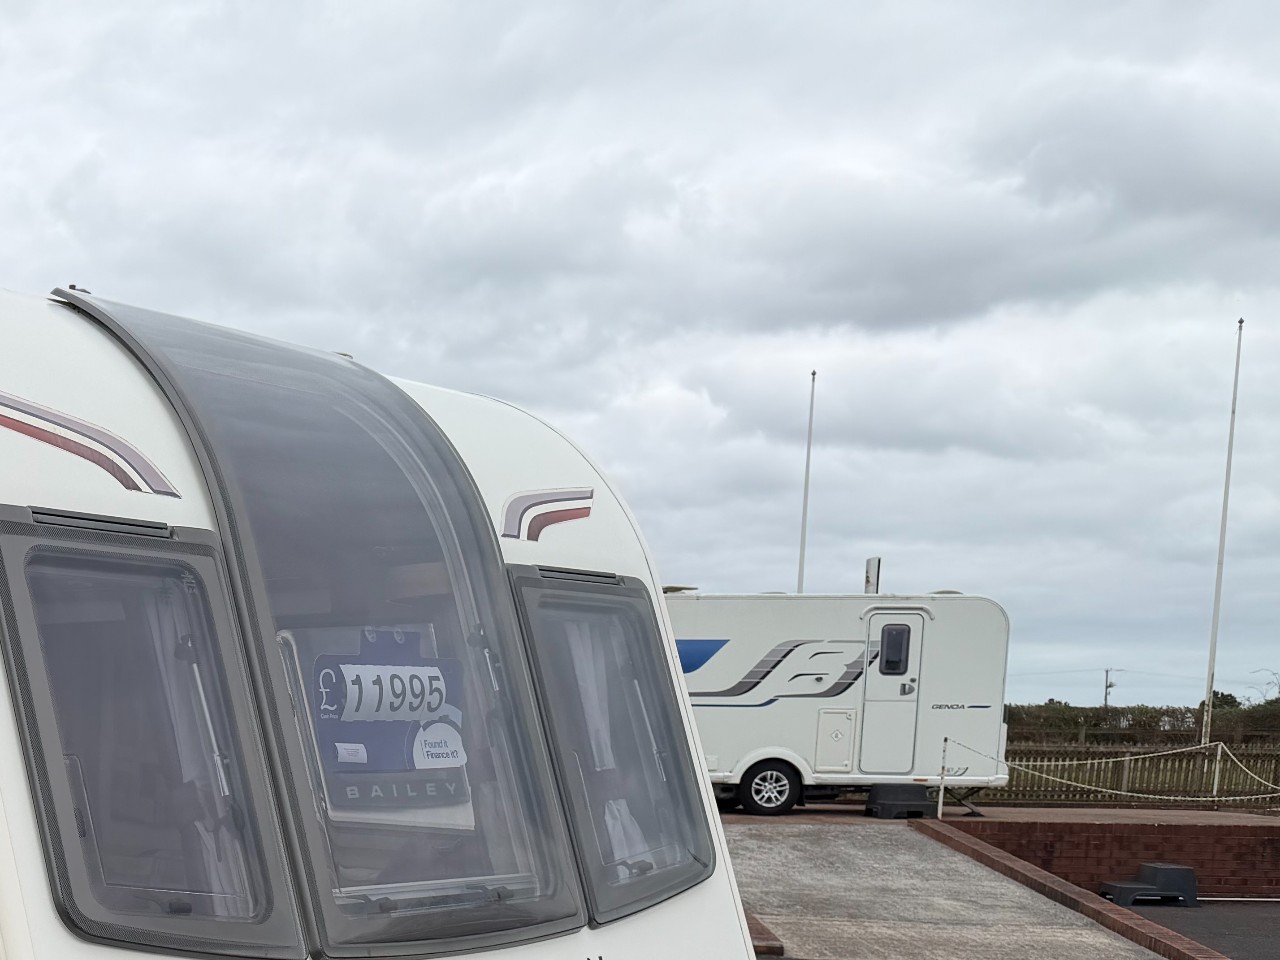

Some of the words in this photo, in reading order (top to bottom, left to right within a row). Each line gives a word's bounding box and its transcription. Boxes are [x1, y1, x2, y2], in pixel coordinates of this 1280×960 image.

[320, 668, 337, 710] £
[351, 674, 443, 712] 11995
[424, 740, 444, 749] Found
[443, 740, 449, 749] it
[426, 751, 450, 760] Finance
[450, 750, 459, 759] it?
[346, 783, 457, 799] BAILEY
